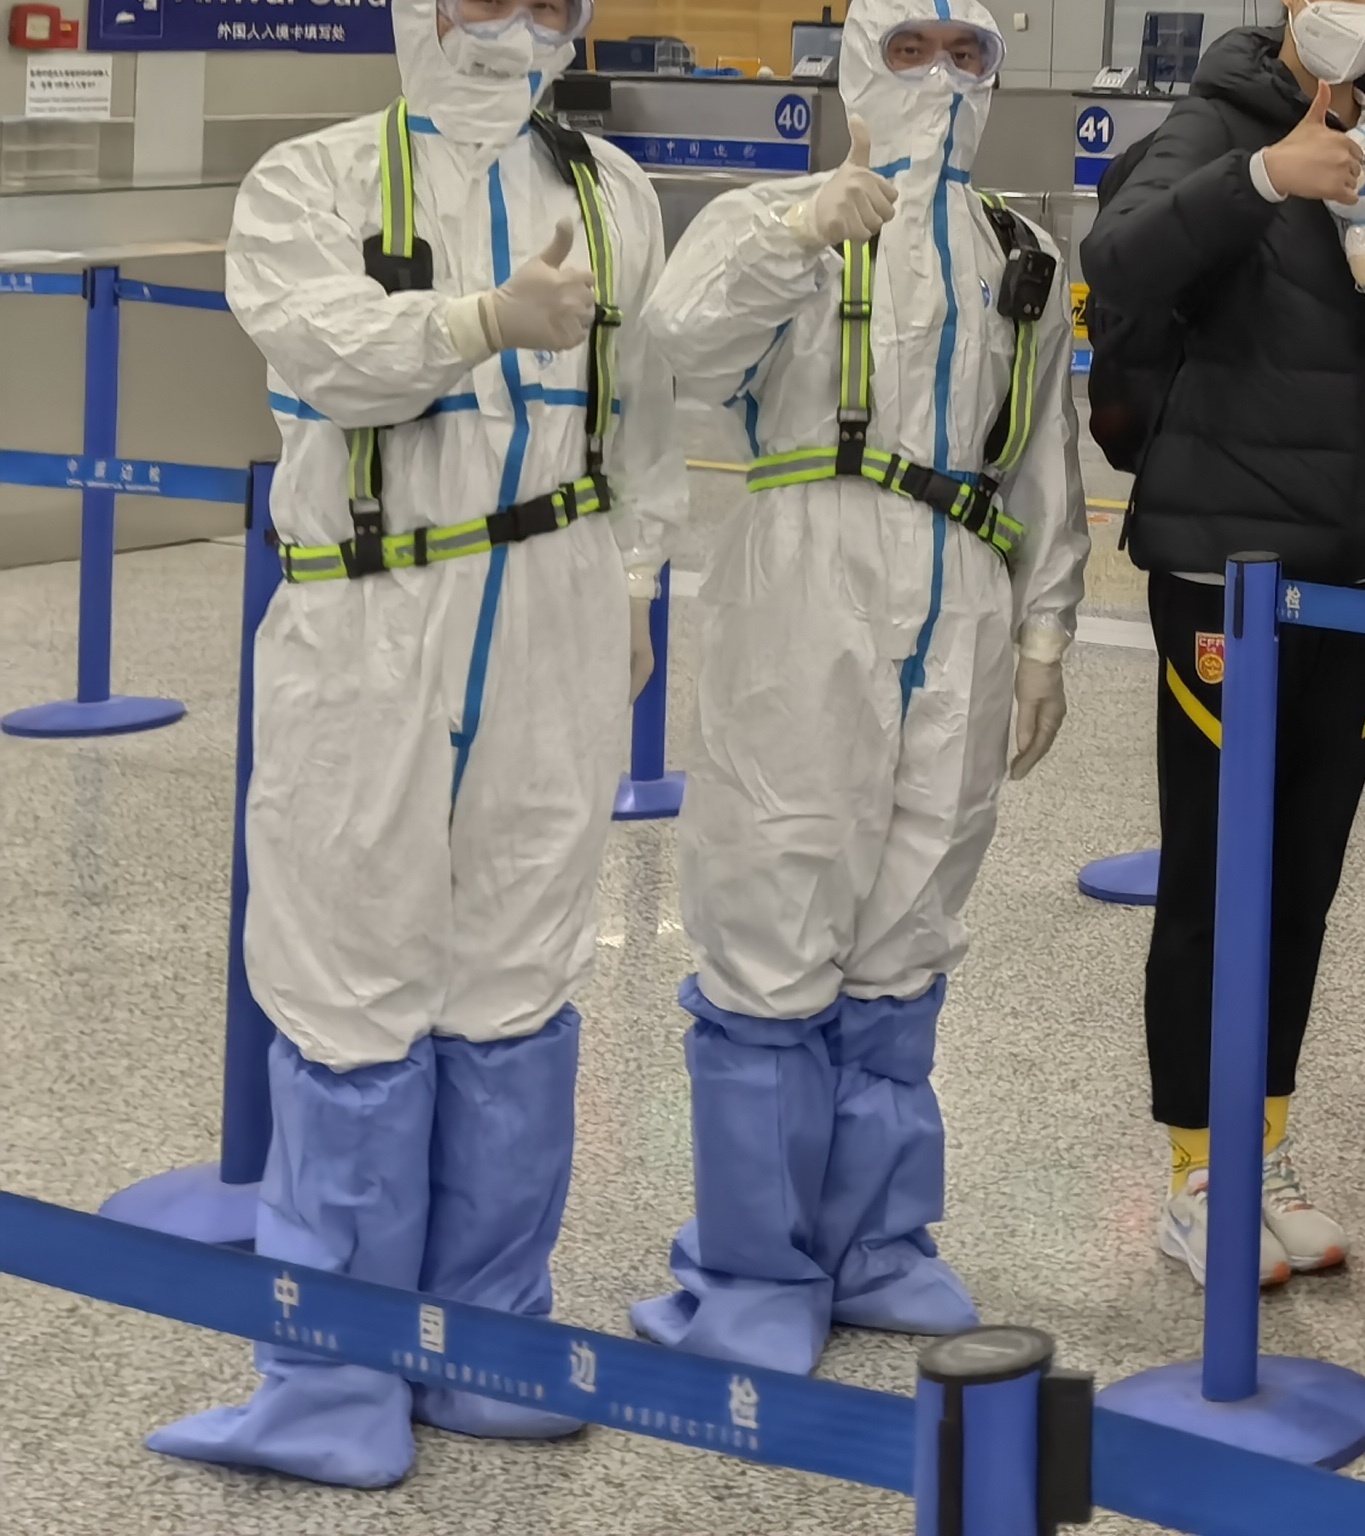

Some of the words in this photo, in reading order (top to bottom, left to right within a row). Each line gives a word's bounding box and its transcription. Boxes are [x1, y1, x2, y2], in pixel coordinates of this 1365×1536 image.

[778, 104, 807, 131] 40
[1078, 116, 1110, 143] 41
[274, 1270, 760, 1429] 中国边检
